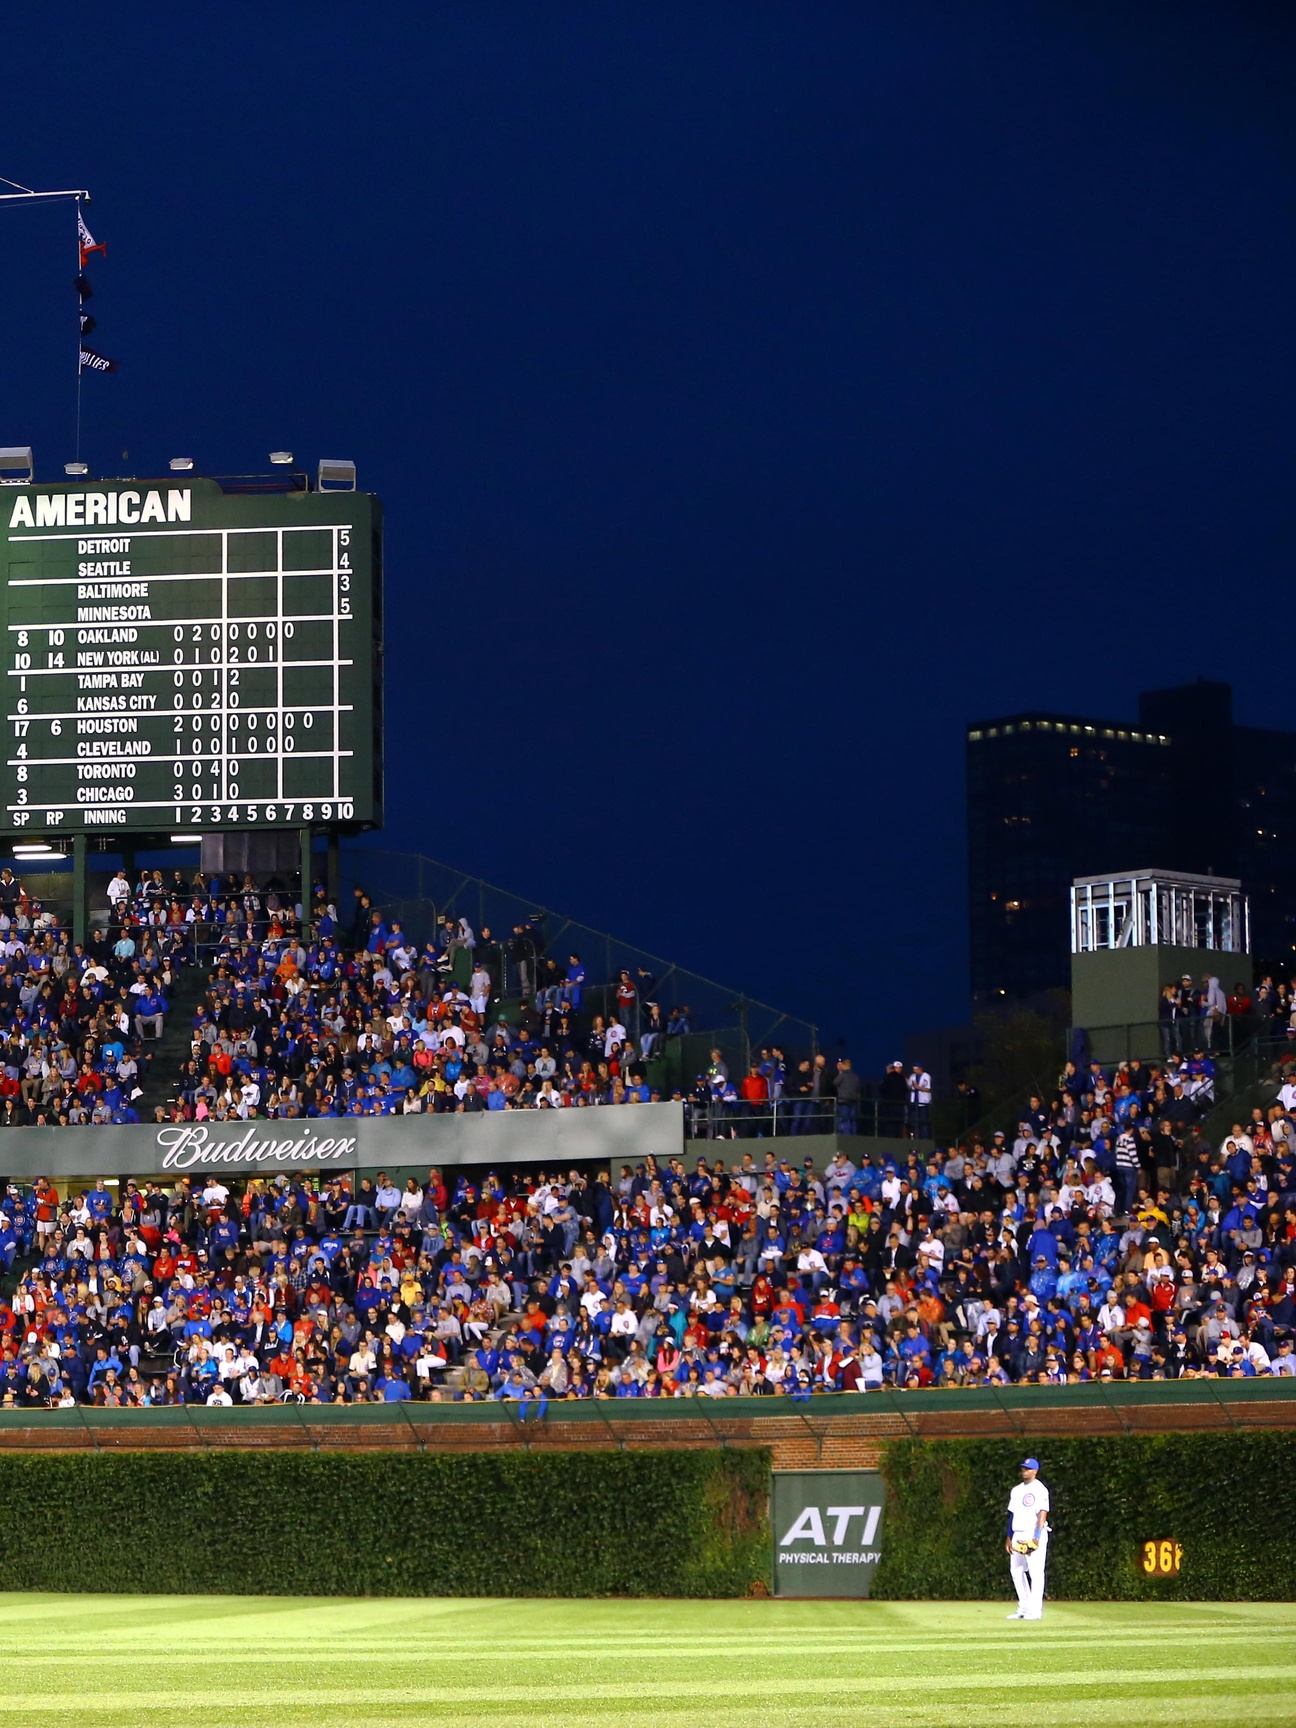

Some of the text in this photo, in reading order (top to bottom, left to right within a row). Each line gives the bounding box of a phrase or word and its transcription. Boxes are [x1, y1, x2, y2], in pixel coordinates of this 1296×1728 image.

[9, 489, 190, 528] AMERICAN
[78, 530, 349, 554] DETROIT 5
[78, 553, 349, 576] SEATTLE 4
[78, 576, 350, 598] BALTIMORE 3
[78, 598, 350, 621] MINNESOTA 5
[18, 622, 294, 646] 8 10 OAKLAND 0 2 0 0 0 0 0
[16, 654, 30, 669] 10
[48, 653, 64, 668] 14
[78, 652, 104, 666] NEW
[78, 674, 118, 688] TAMPA
[122, 673, 144, 687] BAY
[18, 692, 239, 714] 6 KANSAS CITY 0 0 2 0
[15, 718, 137, 736] 17 6 HOUSTON
[17, 741, 150, 759] 4 CLEVELAND
[17, 764, 136, 781] 8 TORONTO
[17, 786, 133, 804] 3 CHICAGO
[13, 812, 29, 826] SP
[47, 812, 63, 825] RP
[84, 810, 126, 824] INNING
[191, 807, 201, 822] 2
[211, 806, 221, 822] 3
[228, 806, 239, 821] 4
[247, 806, 257, 821] 5
[266, 805, 276, 820] 6
[284, 805, 294, 820] 7
[303, 804, 313, 820] 8
[322, 804, 332, 819] 9
[338, 803, 353, 819] 10
[157, 1126, 356, 1168] Budweiser
[779, 1506, 882, 1546] ATI
[779, 1552, 882, 1564] PHYSICAL THERAPY
